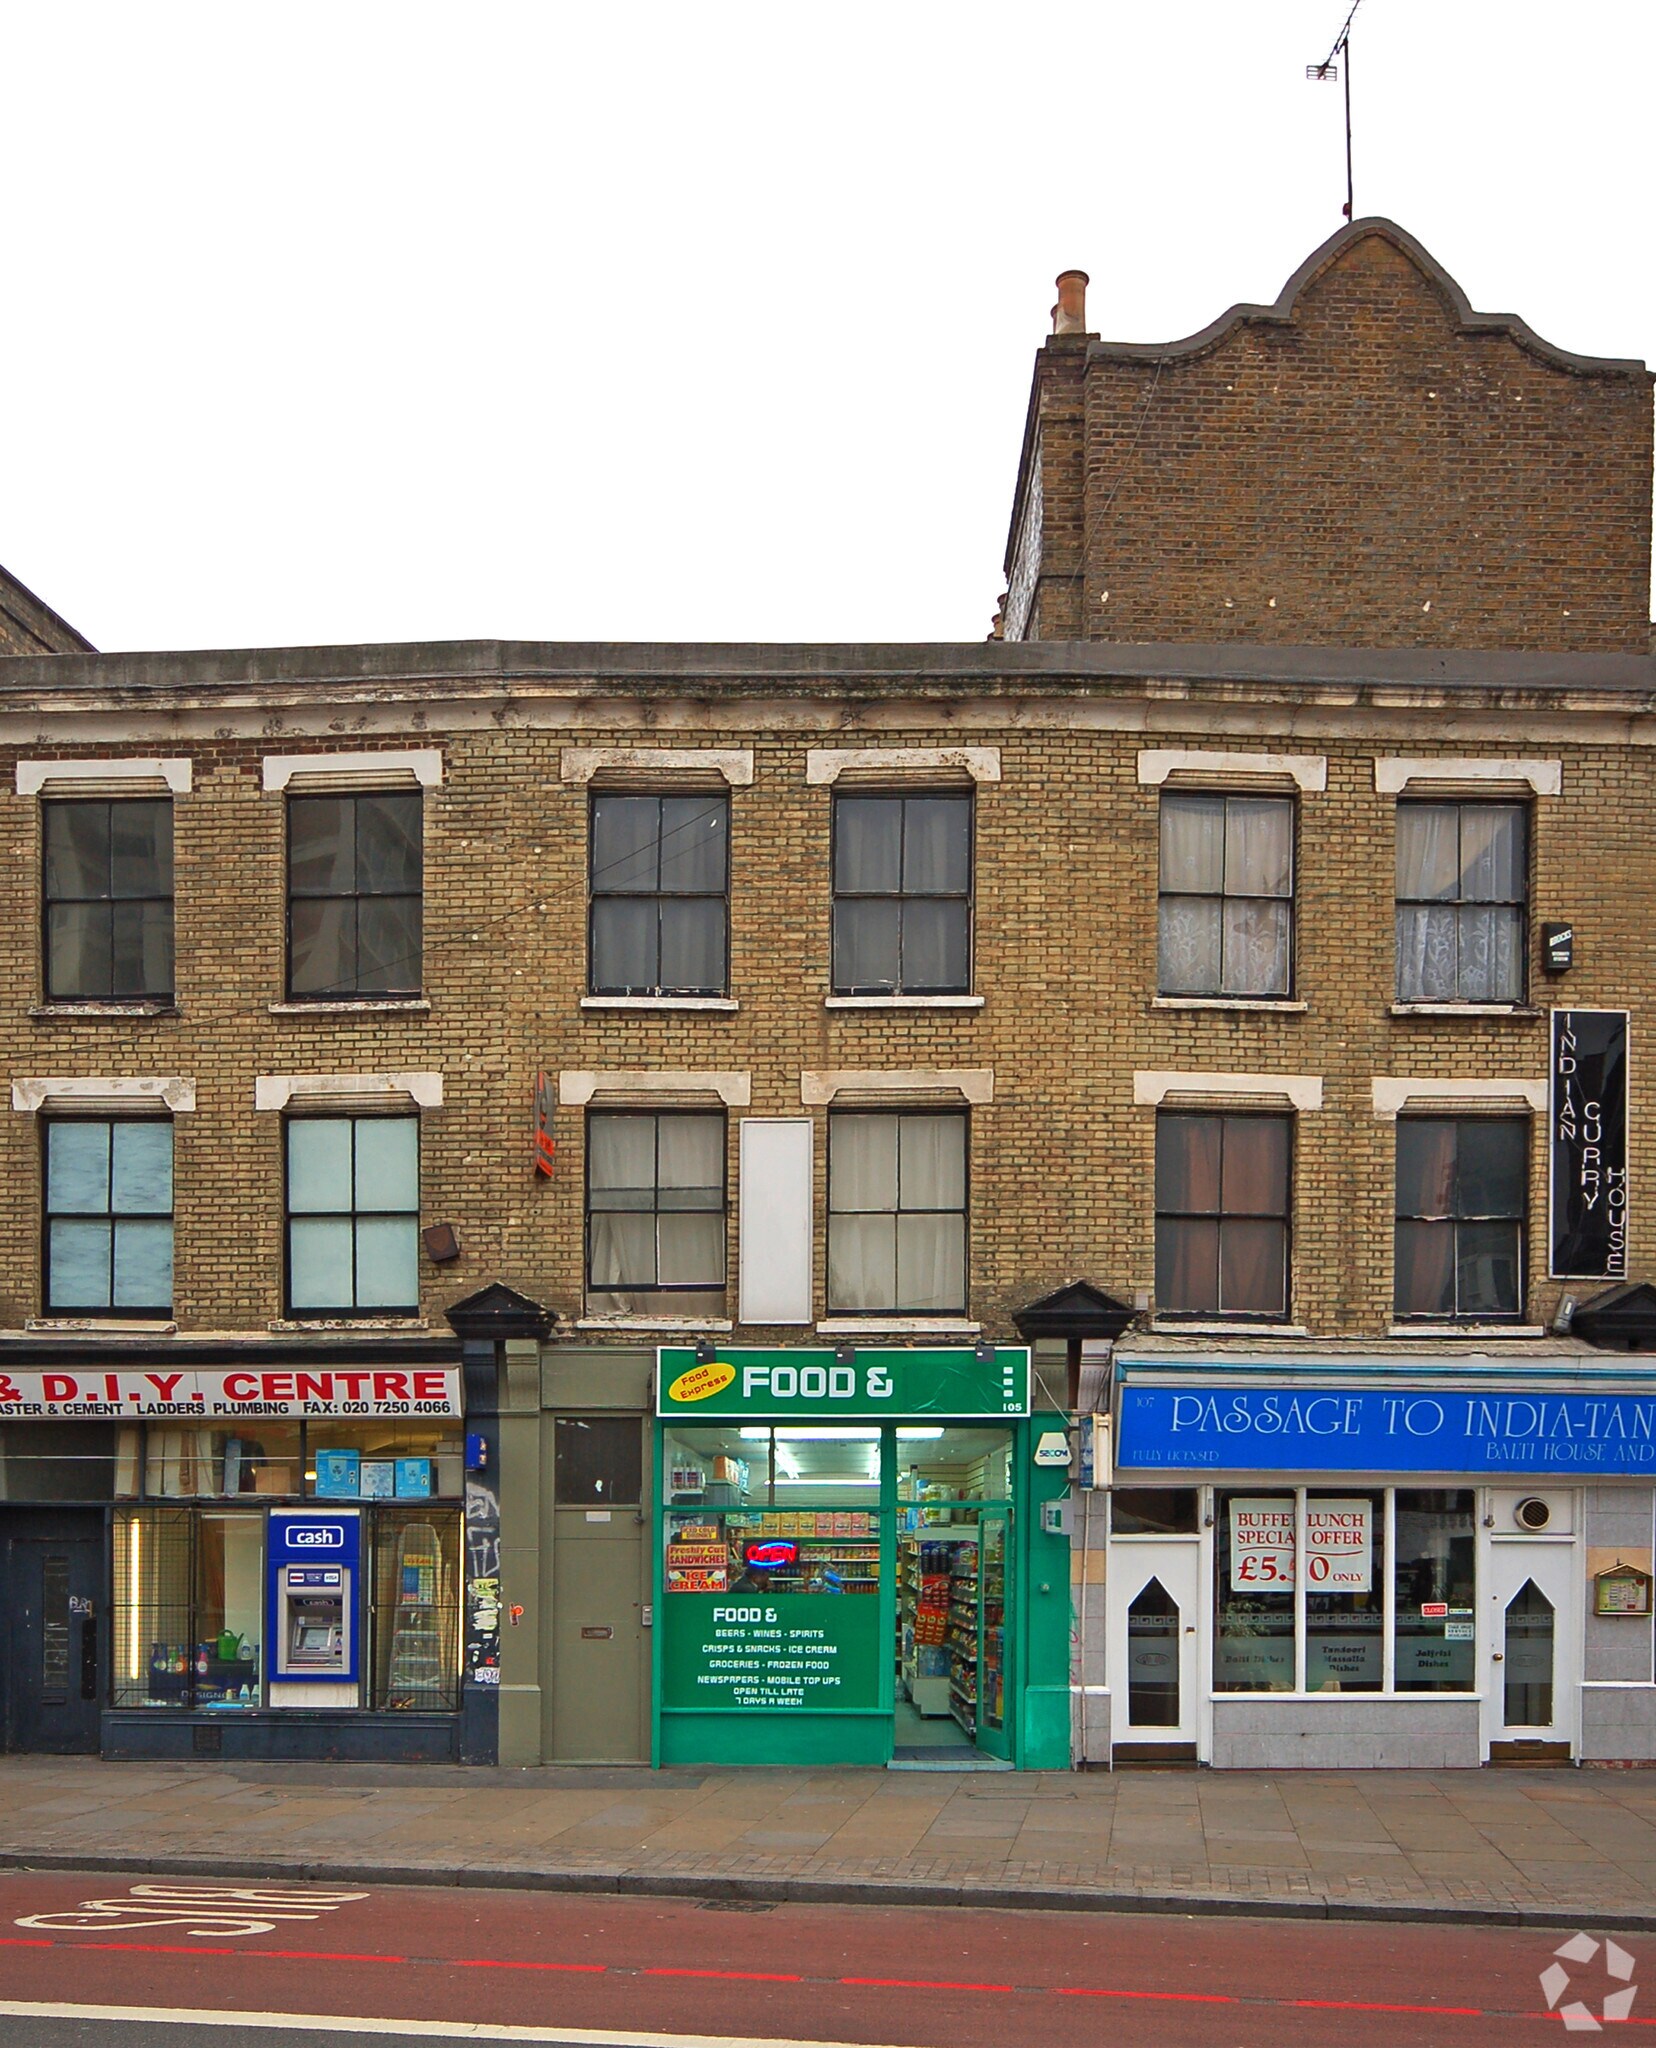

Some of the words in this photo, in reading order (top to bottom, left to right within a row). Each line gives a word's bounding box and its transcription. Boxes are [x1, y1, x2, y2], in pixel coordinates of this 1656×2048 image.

[1559, 1013, 1576, 1140] INDIAN
[1581, 1102, 1601, 1210] CURRY
[1607, 1167, 1626, 1272] HOUSE
[681, 1369, 709, 1386] Food
[743, 1367, 856, 1398] FOOD
[866, 1367, 894, 1398] &
[0, 1374, 23, 1401] &
[42, 1373, 204, 1401] D.I.Y.
[222, 1372, 447, 1400] CENTRE
[680, 1375, 728, 1399] Express
[47, 1403, 59, 1414] &
[63, 1403, 124, 1415] CEMENT
[137, 1403, 205, 1415] LADDERS
[213, 1402, 289, 1414] PLUMBING
[303, 1402, 338, 1414] FAX:
[342, 1401, 369, 1414] 020
[373, 1401, 410, 1414] 7250
[413, 1401, 451, 1414] 4066
[1003, 1403, 1022, 1412] 105
[1170, 1395, 1363, 1435] PASSAGE
[1382, 1397, 1445, 1436] TO
[1463, 1400, 1656, 1440] INDIA-TAN
[1039, 1450, 1068, 1458] SECOM
[1486, 1441, 1535, 1460] BALTI
[1544, 1442, 1607, 1461] HOUSE
[1613, 1443, 1655, 1462] AND
[1307, 1513, 1365, 1527] LUNCH
[296, 1529, 333, 1544] cash
[1237, 1531, 1296, 1544] SPECIA
[1311, 1531, 1364, 1545] OFFER
[670, 1546, 707, 1555] Freshly
[746, 1545, 798, 1562] OPEN
[670, 1555, 725, 1564] SANDWICHES
[686, 1571, 707, 1580] ICE
[1332, 1573, 1364, 1582] ONLY
[671, 1581, 723, 1590] CREAM
[713, 1608, 761, 1622] FOOD
[765, 1608, 777, 1622] &
[715, 1629, 746, 1638] BEERS
[753, 1630, 782, 1638] WINES
[789, 1630, 824, 1638] SPIRITS
[702, 1645, 735, 1653] CRISPS
[736, 1645, 743, 1653] &
[745, 1645, 781, 1653] SNACKS
[788, 1645, 803, 1653] ICE
[805, 1646, 837, 1654] CREAM
[709, 1660, 760, 1669] GROCERIES
[767, 1661, 803, 1669] FROZEN
[805, 1661, 829, 1669] FOOD
[1328, 1664, 1360, 1672] Dishes
[1417, 1660, 1449, 1668] Dishes
[697, 1675, 760, 1684] NEWSPAPERS
[767, 1676, 801, 1684] MOBILE
[803, 1676, 821, 1685] TOP
[822, 1677, 841, 1685] UPS
[733, 1687, 758, 1695] OPEN
[743, 1697, 767, 1705] DAYS
[768, 1697, 775, 1705] A
